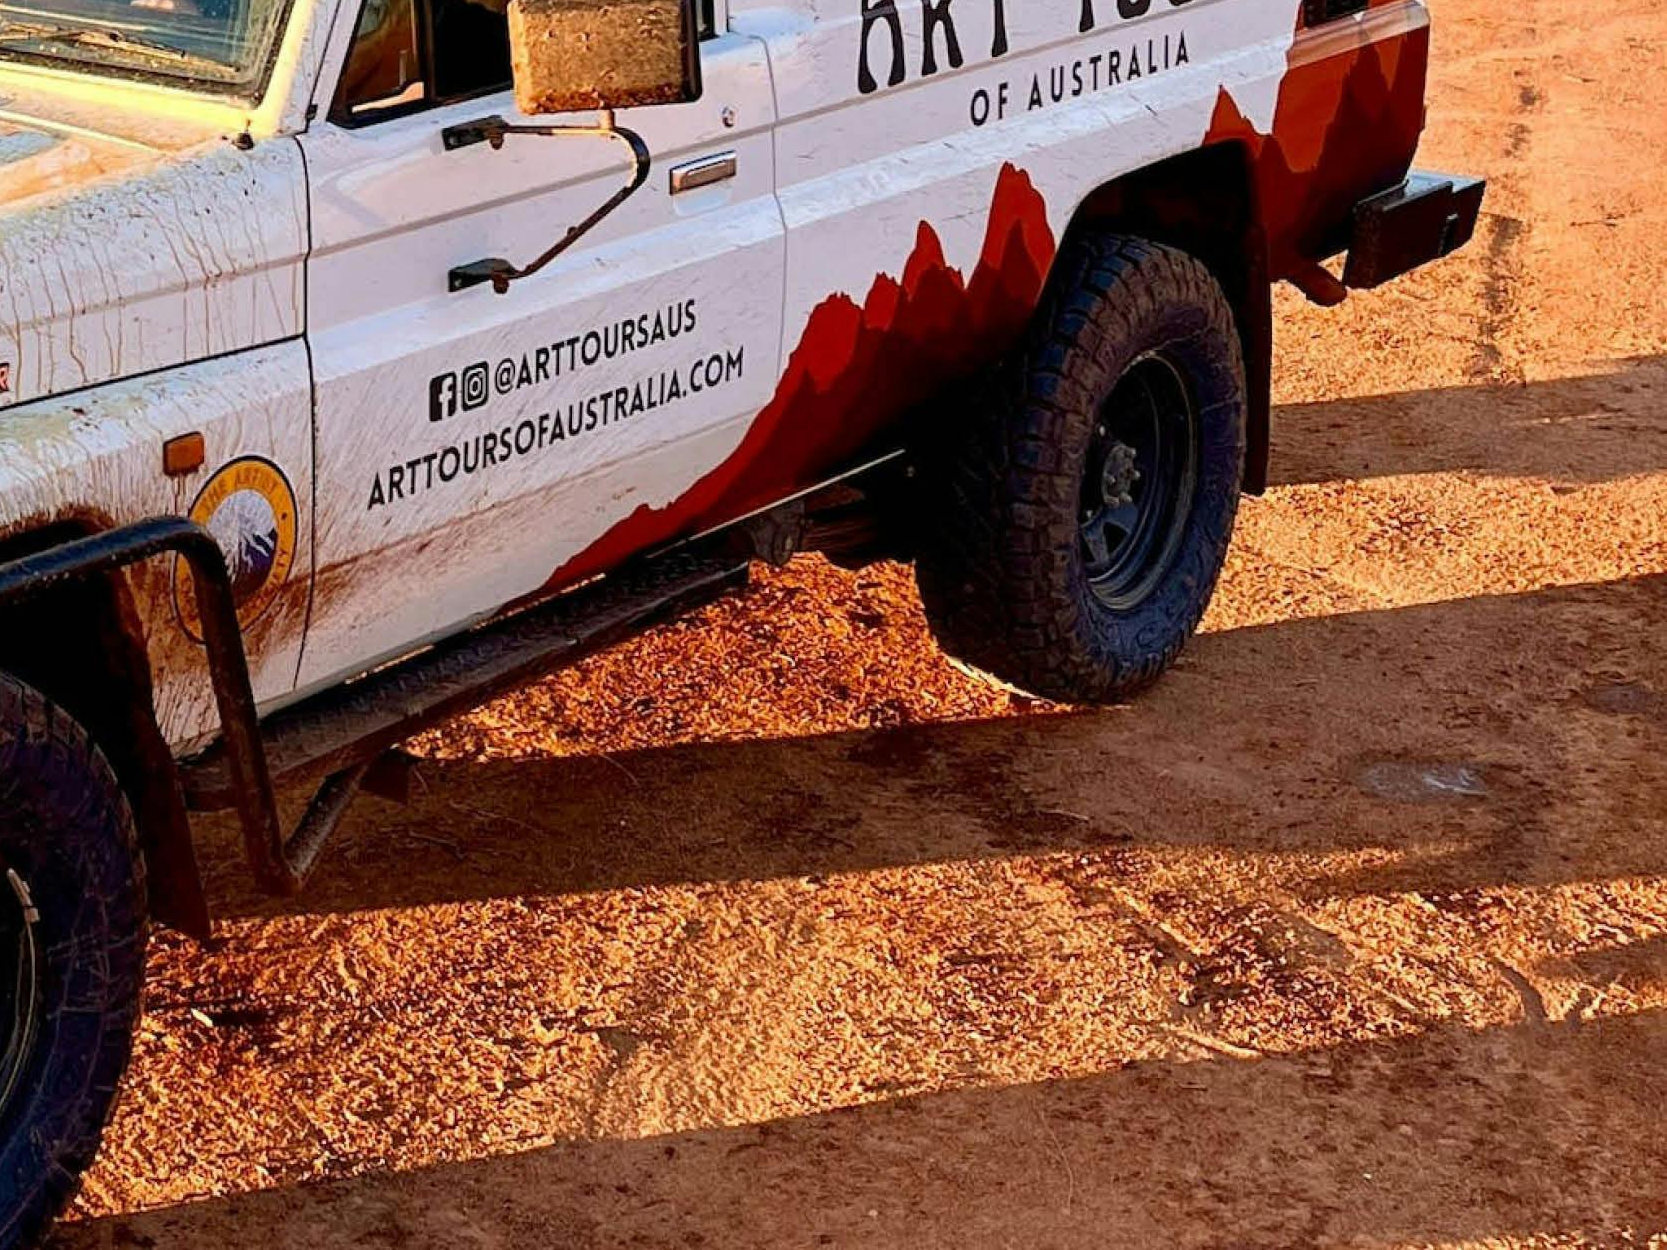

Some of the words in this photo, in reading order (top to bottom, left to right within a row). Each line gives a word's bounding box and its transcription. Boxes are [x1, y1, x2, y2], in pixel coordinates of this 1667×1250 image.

[970, 81, 1009, 127] OF
[1028, 30, 1189, 112] AUSTRALIA
[494, 298, 696, 394] @ARTTOURSAUS
[367, 345, 745, 511] ARTTOURSOFAUSTRALIA.COM
